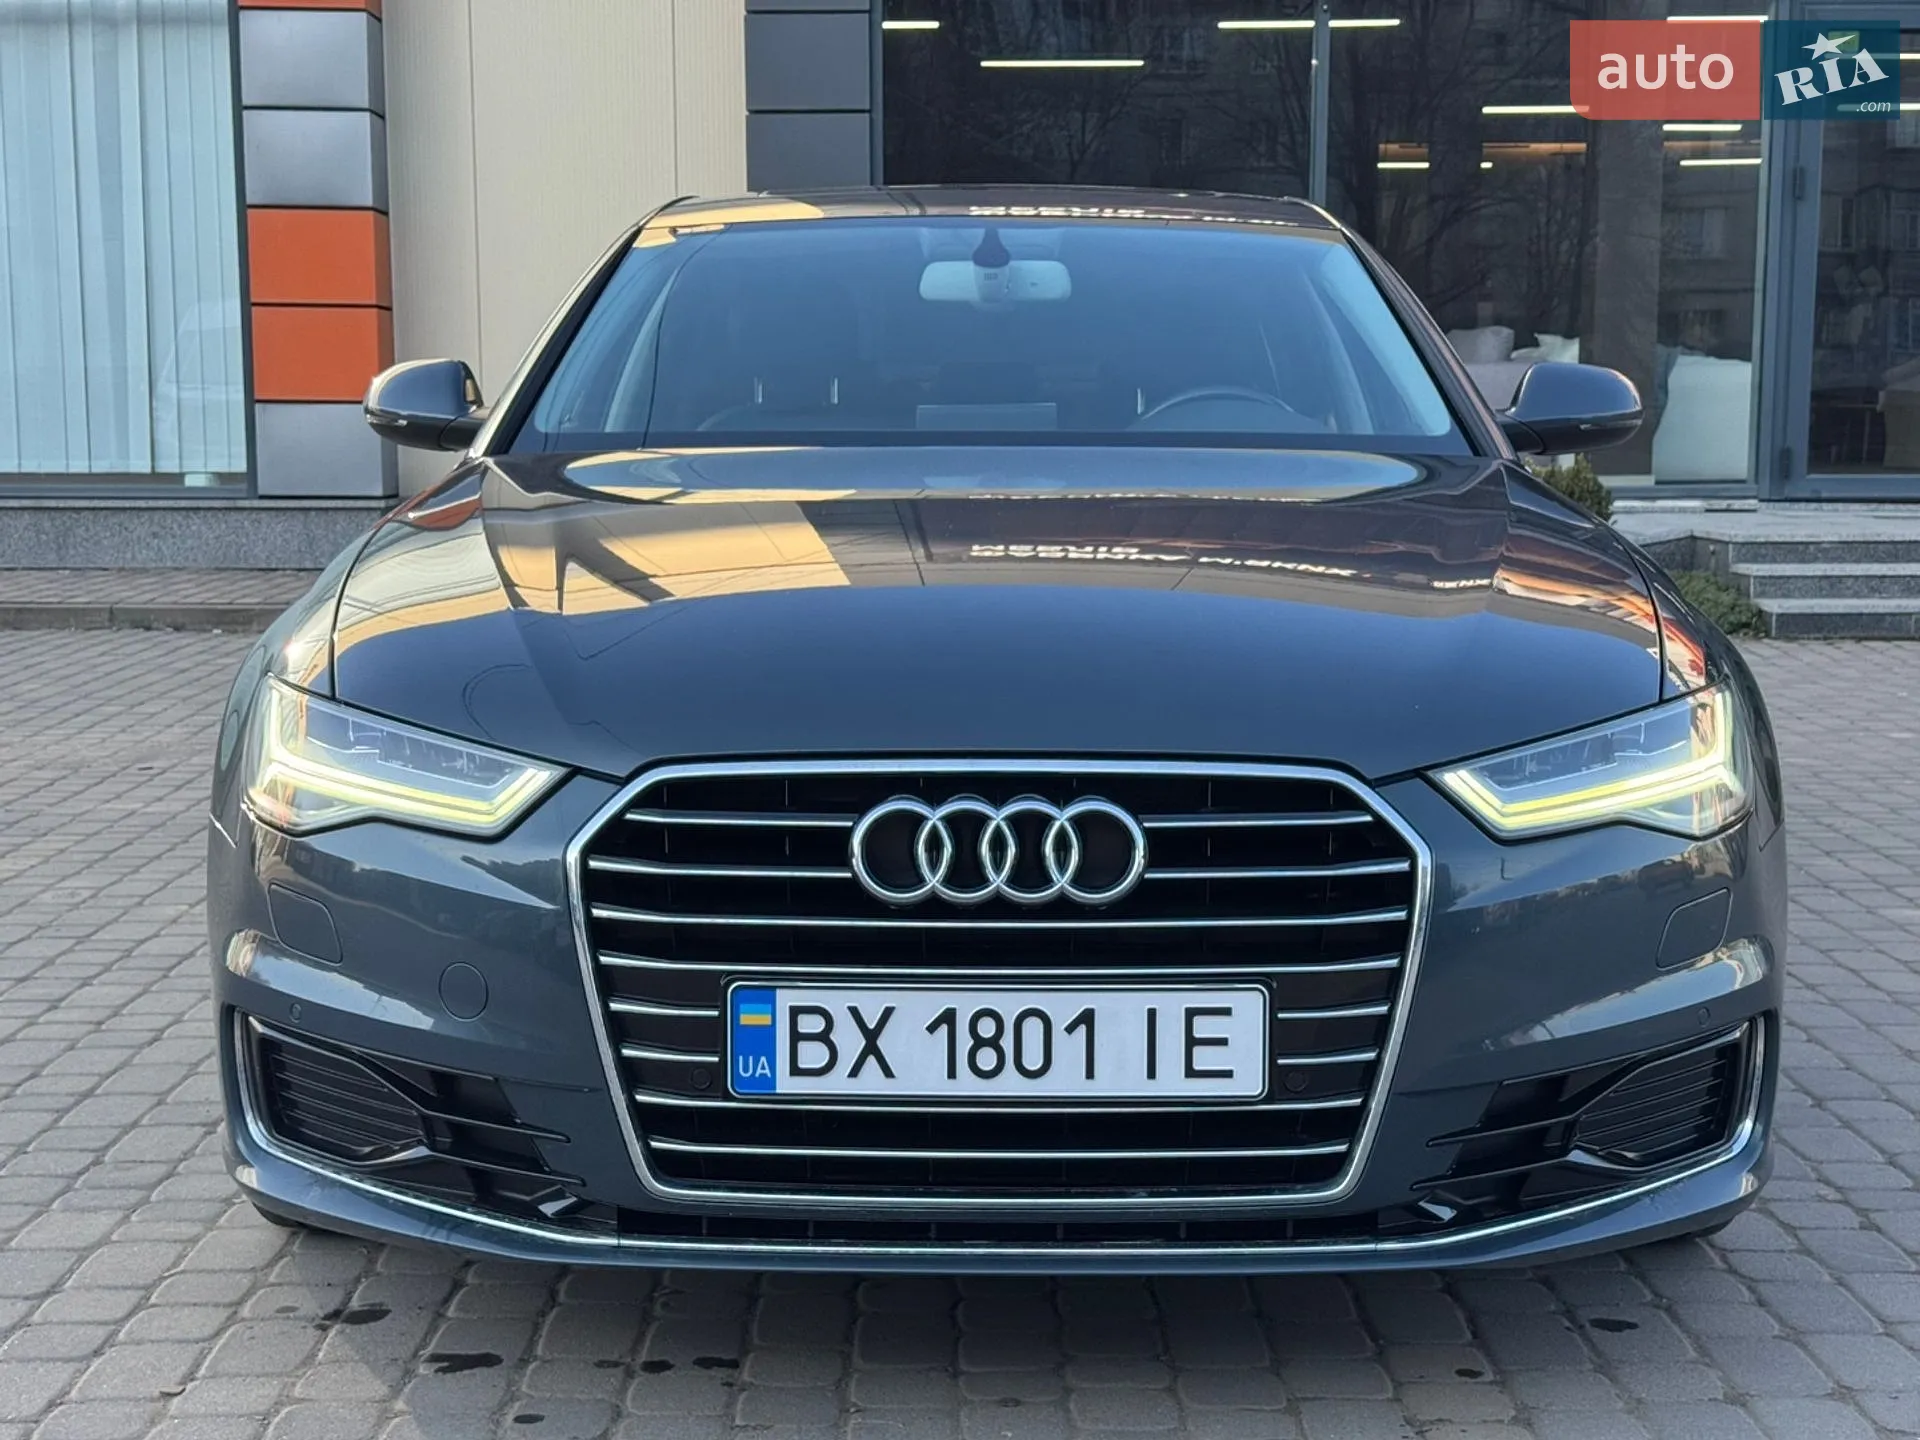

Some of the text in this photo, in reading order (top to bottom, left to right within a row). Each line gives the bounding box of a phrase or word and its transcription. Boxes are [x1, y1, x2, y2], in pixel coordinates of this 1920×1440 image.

[738, 1055, 772, 1078] UA
[788, 1005, 1235, 1081] BX 1801 IE
